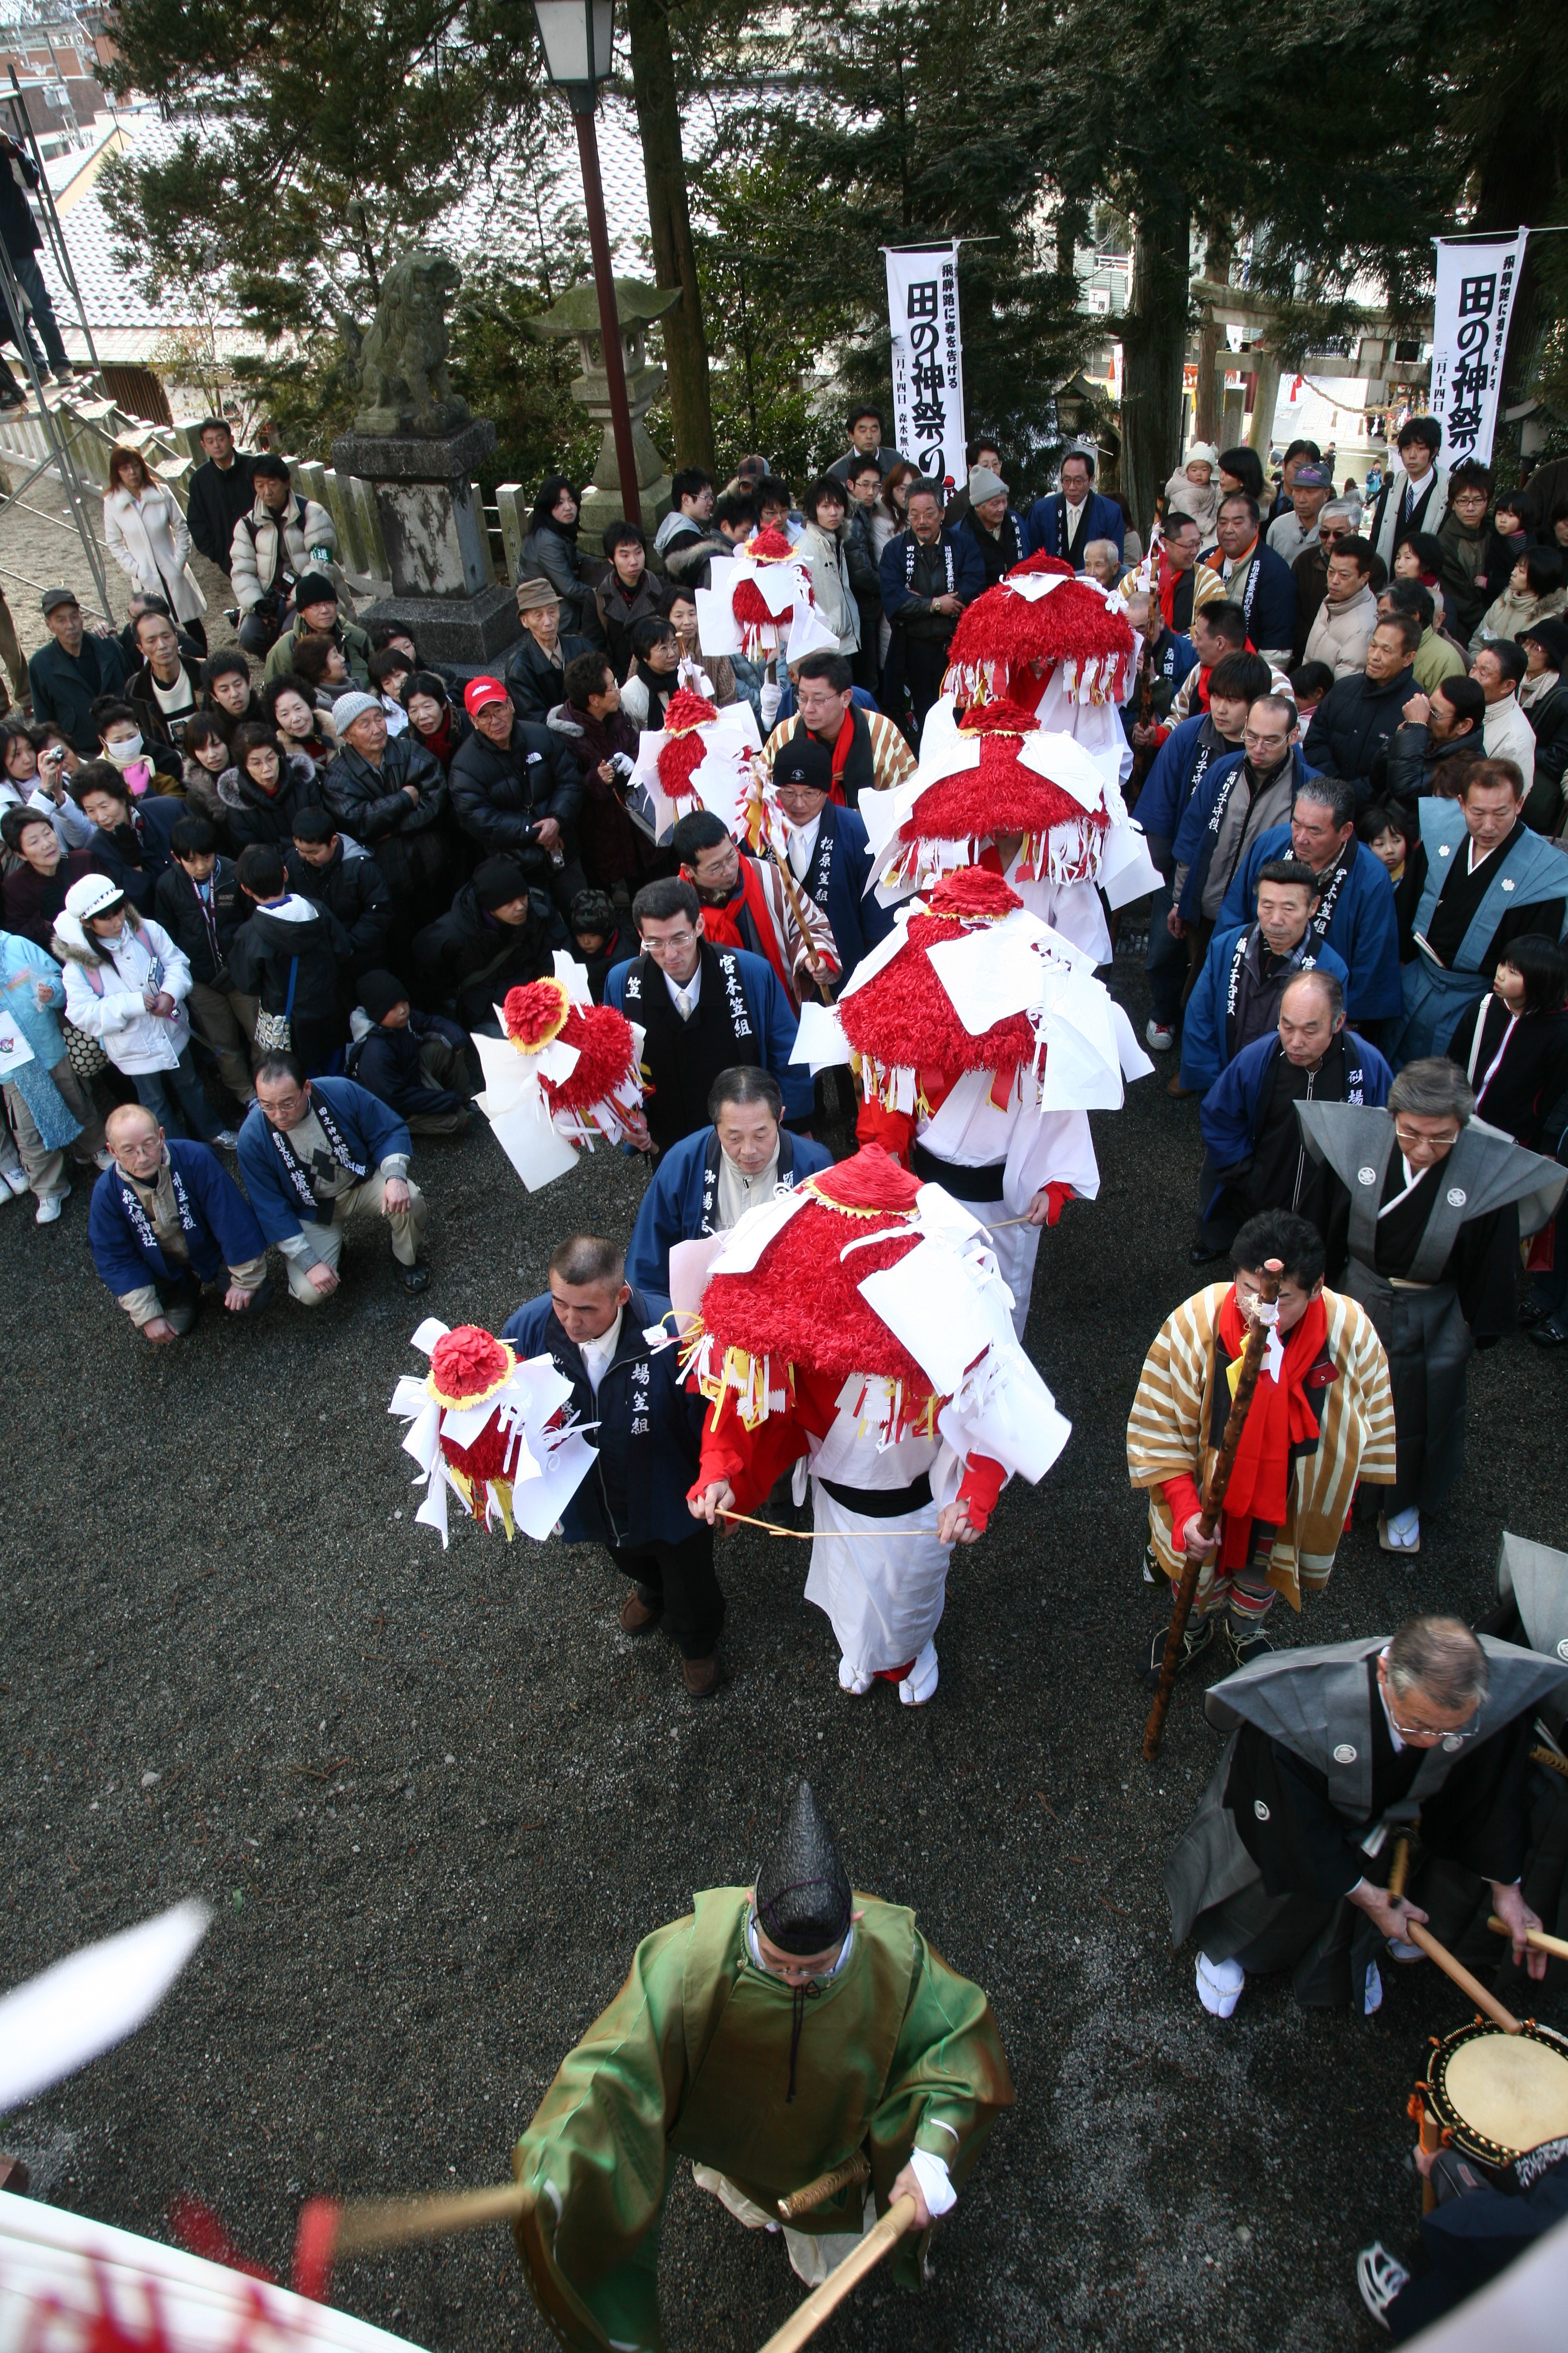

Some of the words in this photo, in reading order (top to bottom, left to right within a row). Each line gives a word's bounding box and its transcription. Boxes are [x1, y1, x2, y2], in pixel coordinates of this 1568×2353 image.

[942, 263, 958, 389] 飛騨路に春を告げる
[896, 350, 907, 405] 二月十四日
[907, 280, 946, 479] 田の神祭り
[1433, 351, 1448, 413] 二月十四日
[898, 412, 910, 463] 森水無八
[815, 836, 833, 902] 松原笠組
[625, 976, 642, 1000] 笠
[719, 954, 752, 1039] 宮本笠組
[122, 1188, 157, 1248] 森八幡神社
[631, 1362, 650, 1435] 場笠組
